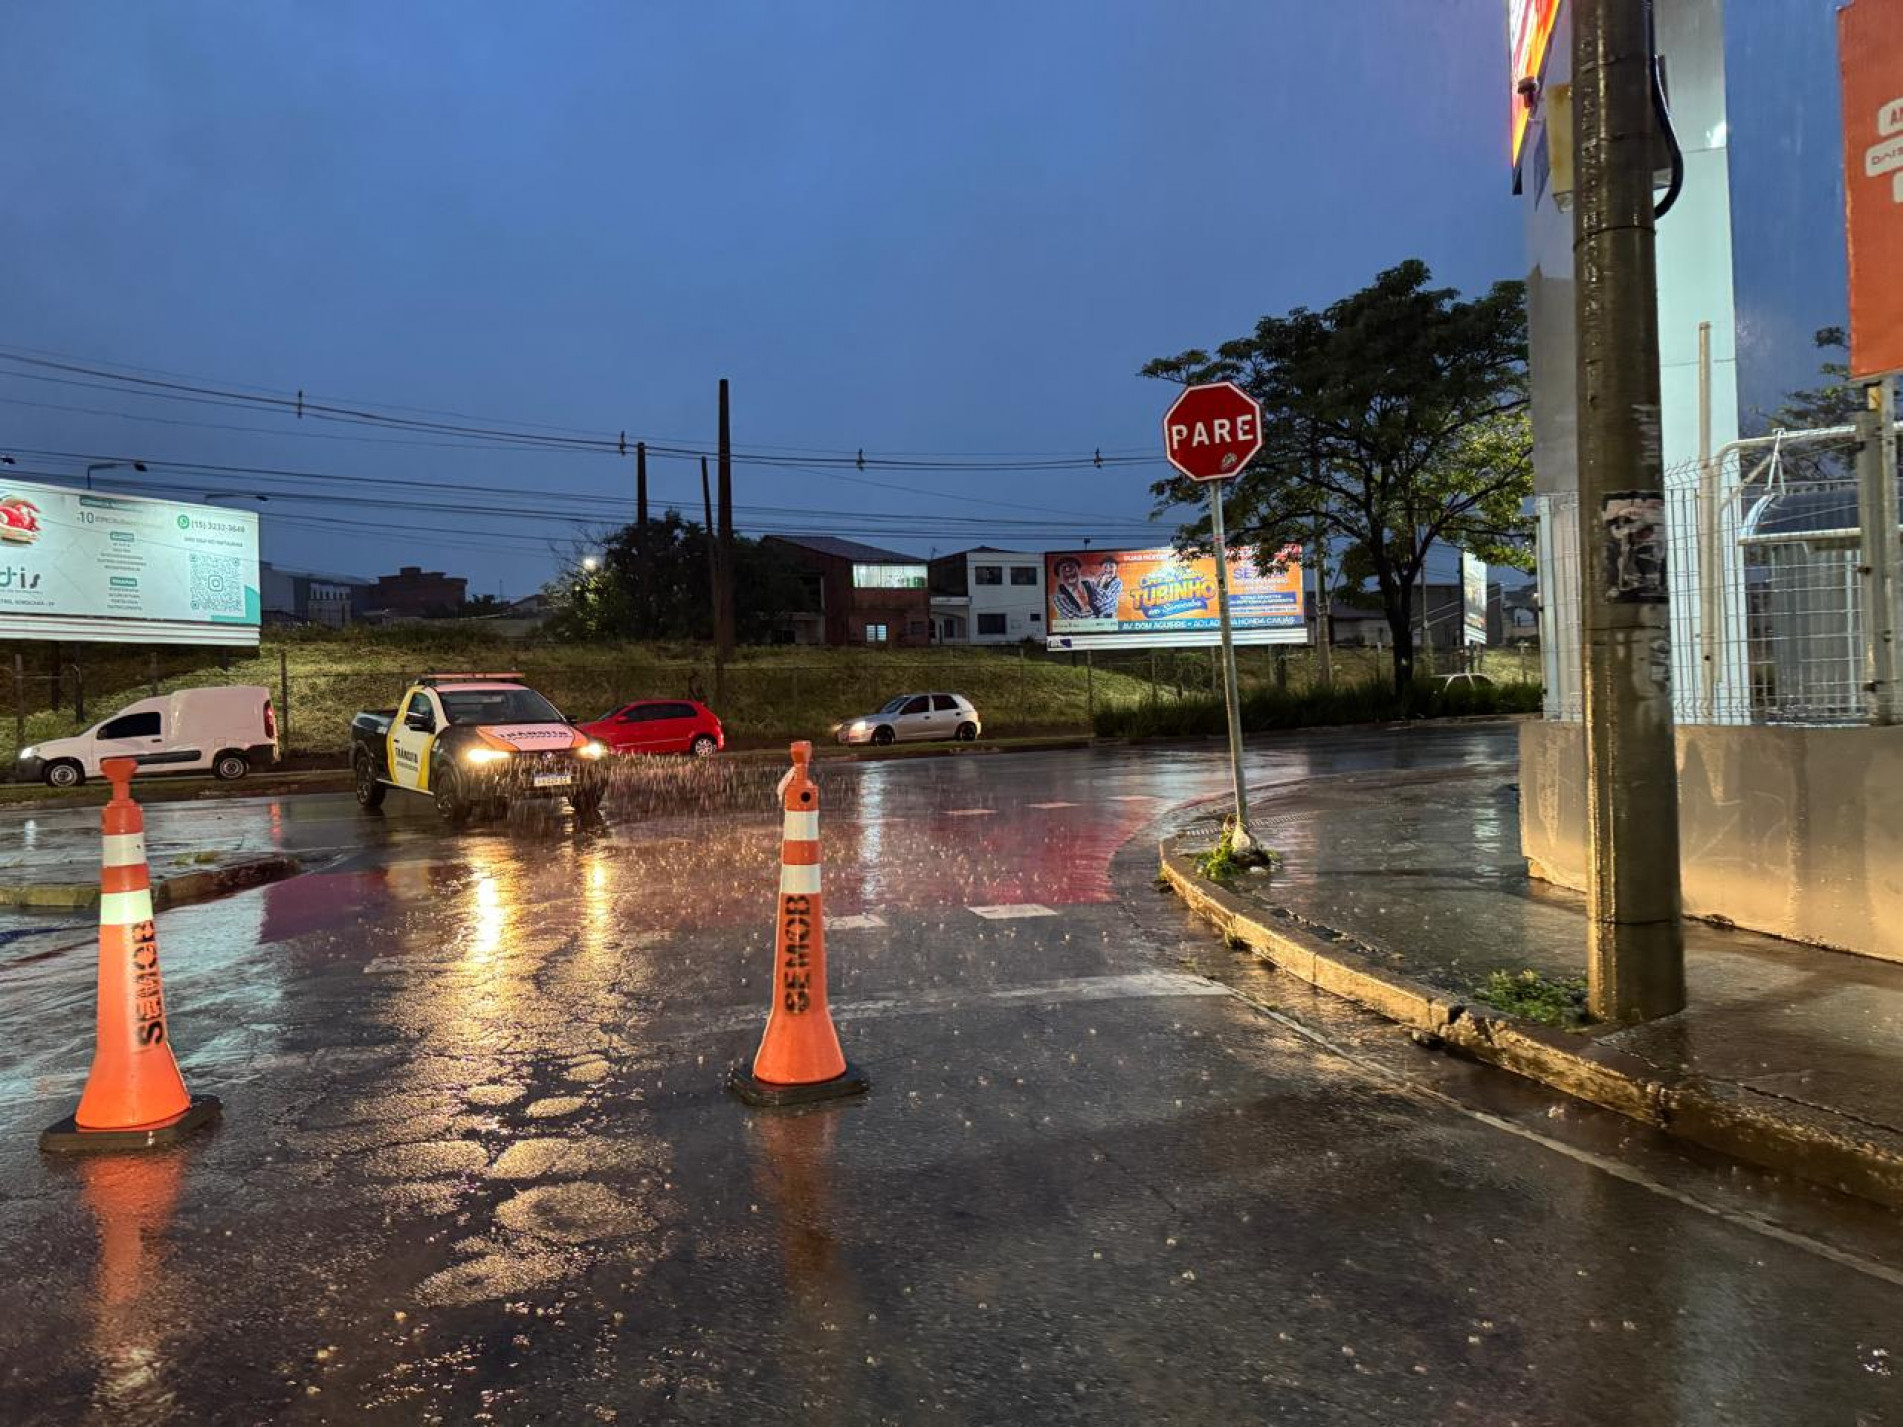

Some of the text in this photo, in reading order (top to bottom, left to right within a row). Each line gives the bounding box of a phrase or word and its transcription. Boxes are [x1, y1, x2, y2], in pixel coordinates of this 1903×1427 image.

[1171, 414, 1254, 450] PARE
[131, 920, 163, 1046] SEMOB
[784, 894, 811, 1015] SEMOB
